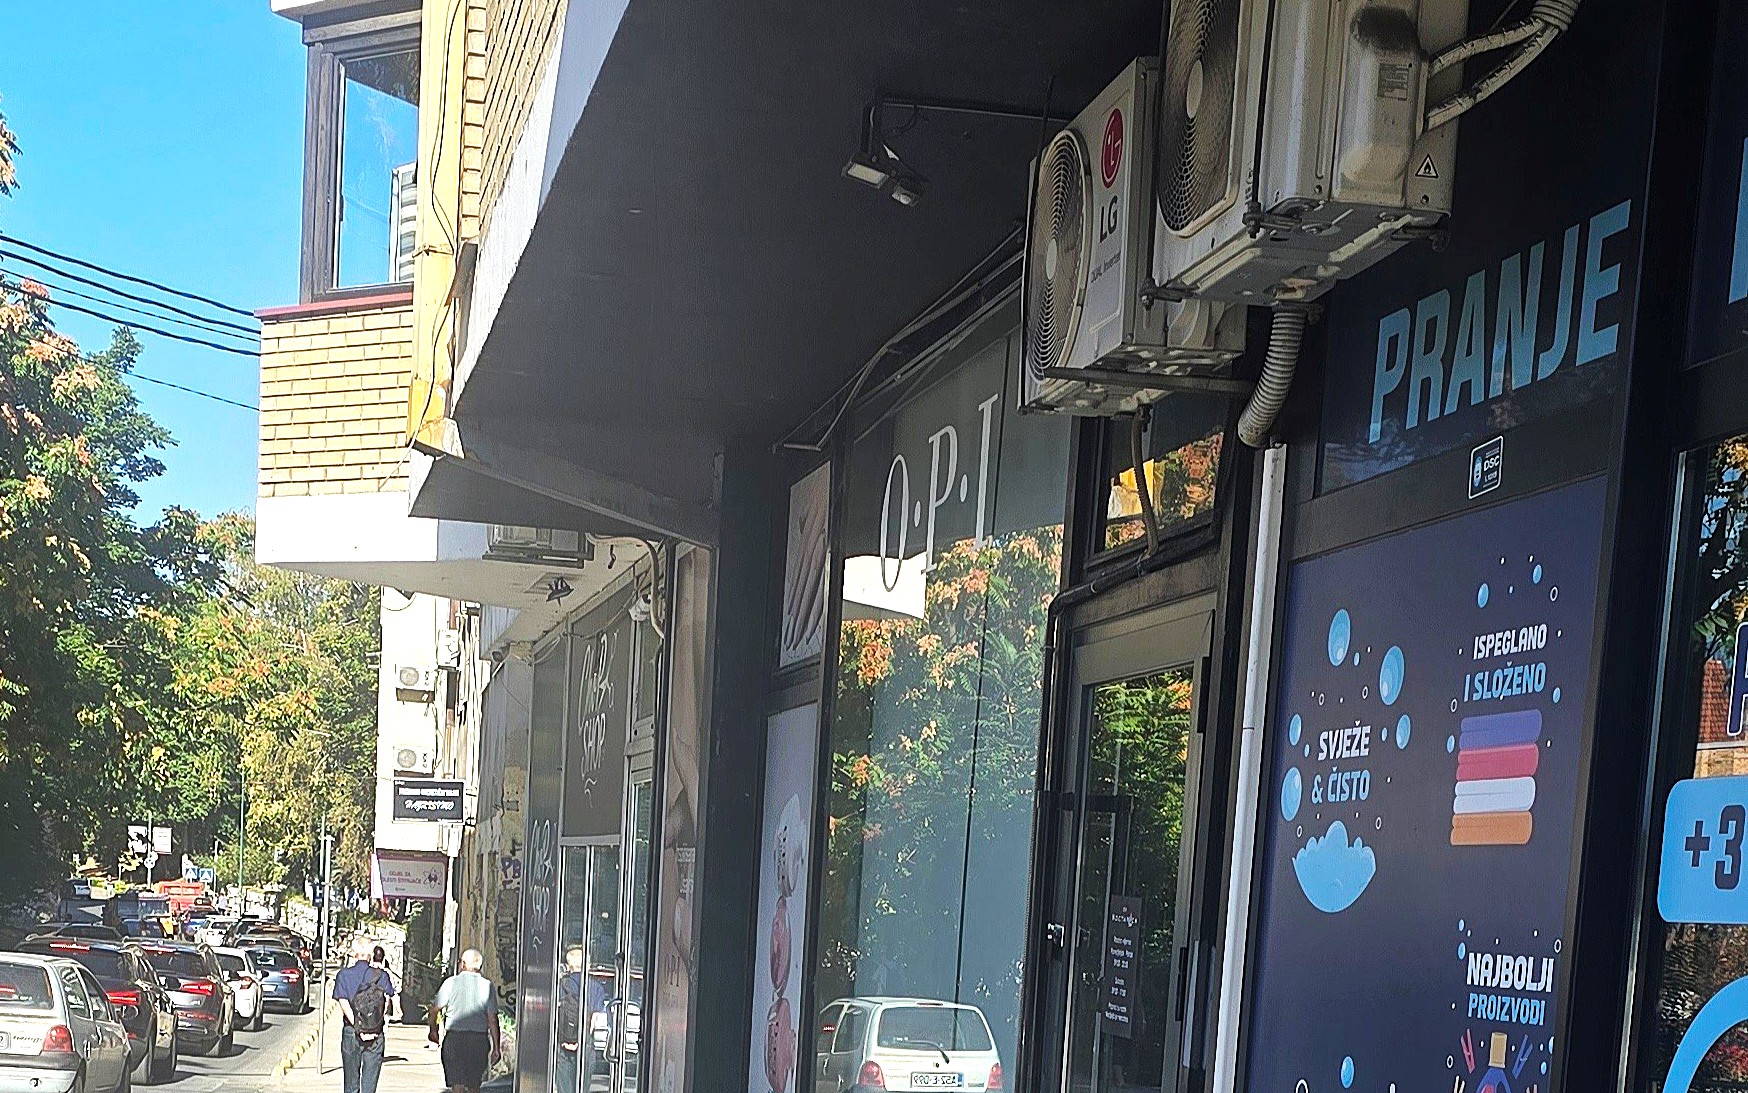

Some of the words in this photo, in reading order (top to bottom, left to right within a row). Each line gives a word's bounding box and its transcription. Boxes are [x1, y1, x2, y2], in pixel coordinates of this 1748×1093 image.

[1100, 195, 1118, 243] LG
[1368, 199, 1631, 444] PRANJE
[1483, 455, 1500, 472] DSC
[1473, 623, 1548, 660] ISPEGLANO
[1464, 678, 1472, 702] I
[1472, 661, 1547, 700] SLOŽENO
[1317, 720, 1371, 761] SVJEŽE
[1312, 774, 1323, 806] &
[1327, 766, 1371, 804] ČISTO
[1466, 952, 1555, 994] NAJBOLJI
[1467, 994, 1546, 1026] PROIZVODI
